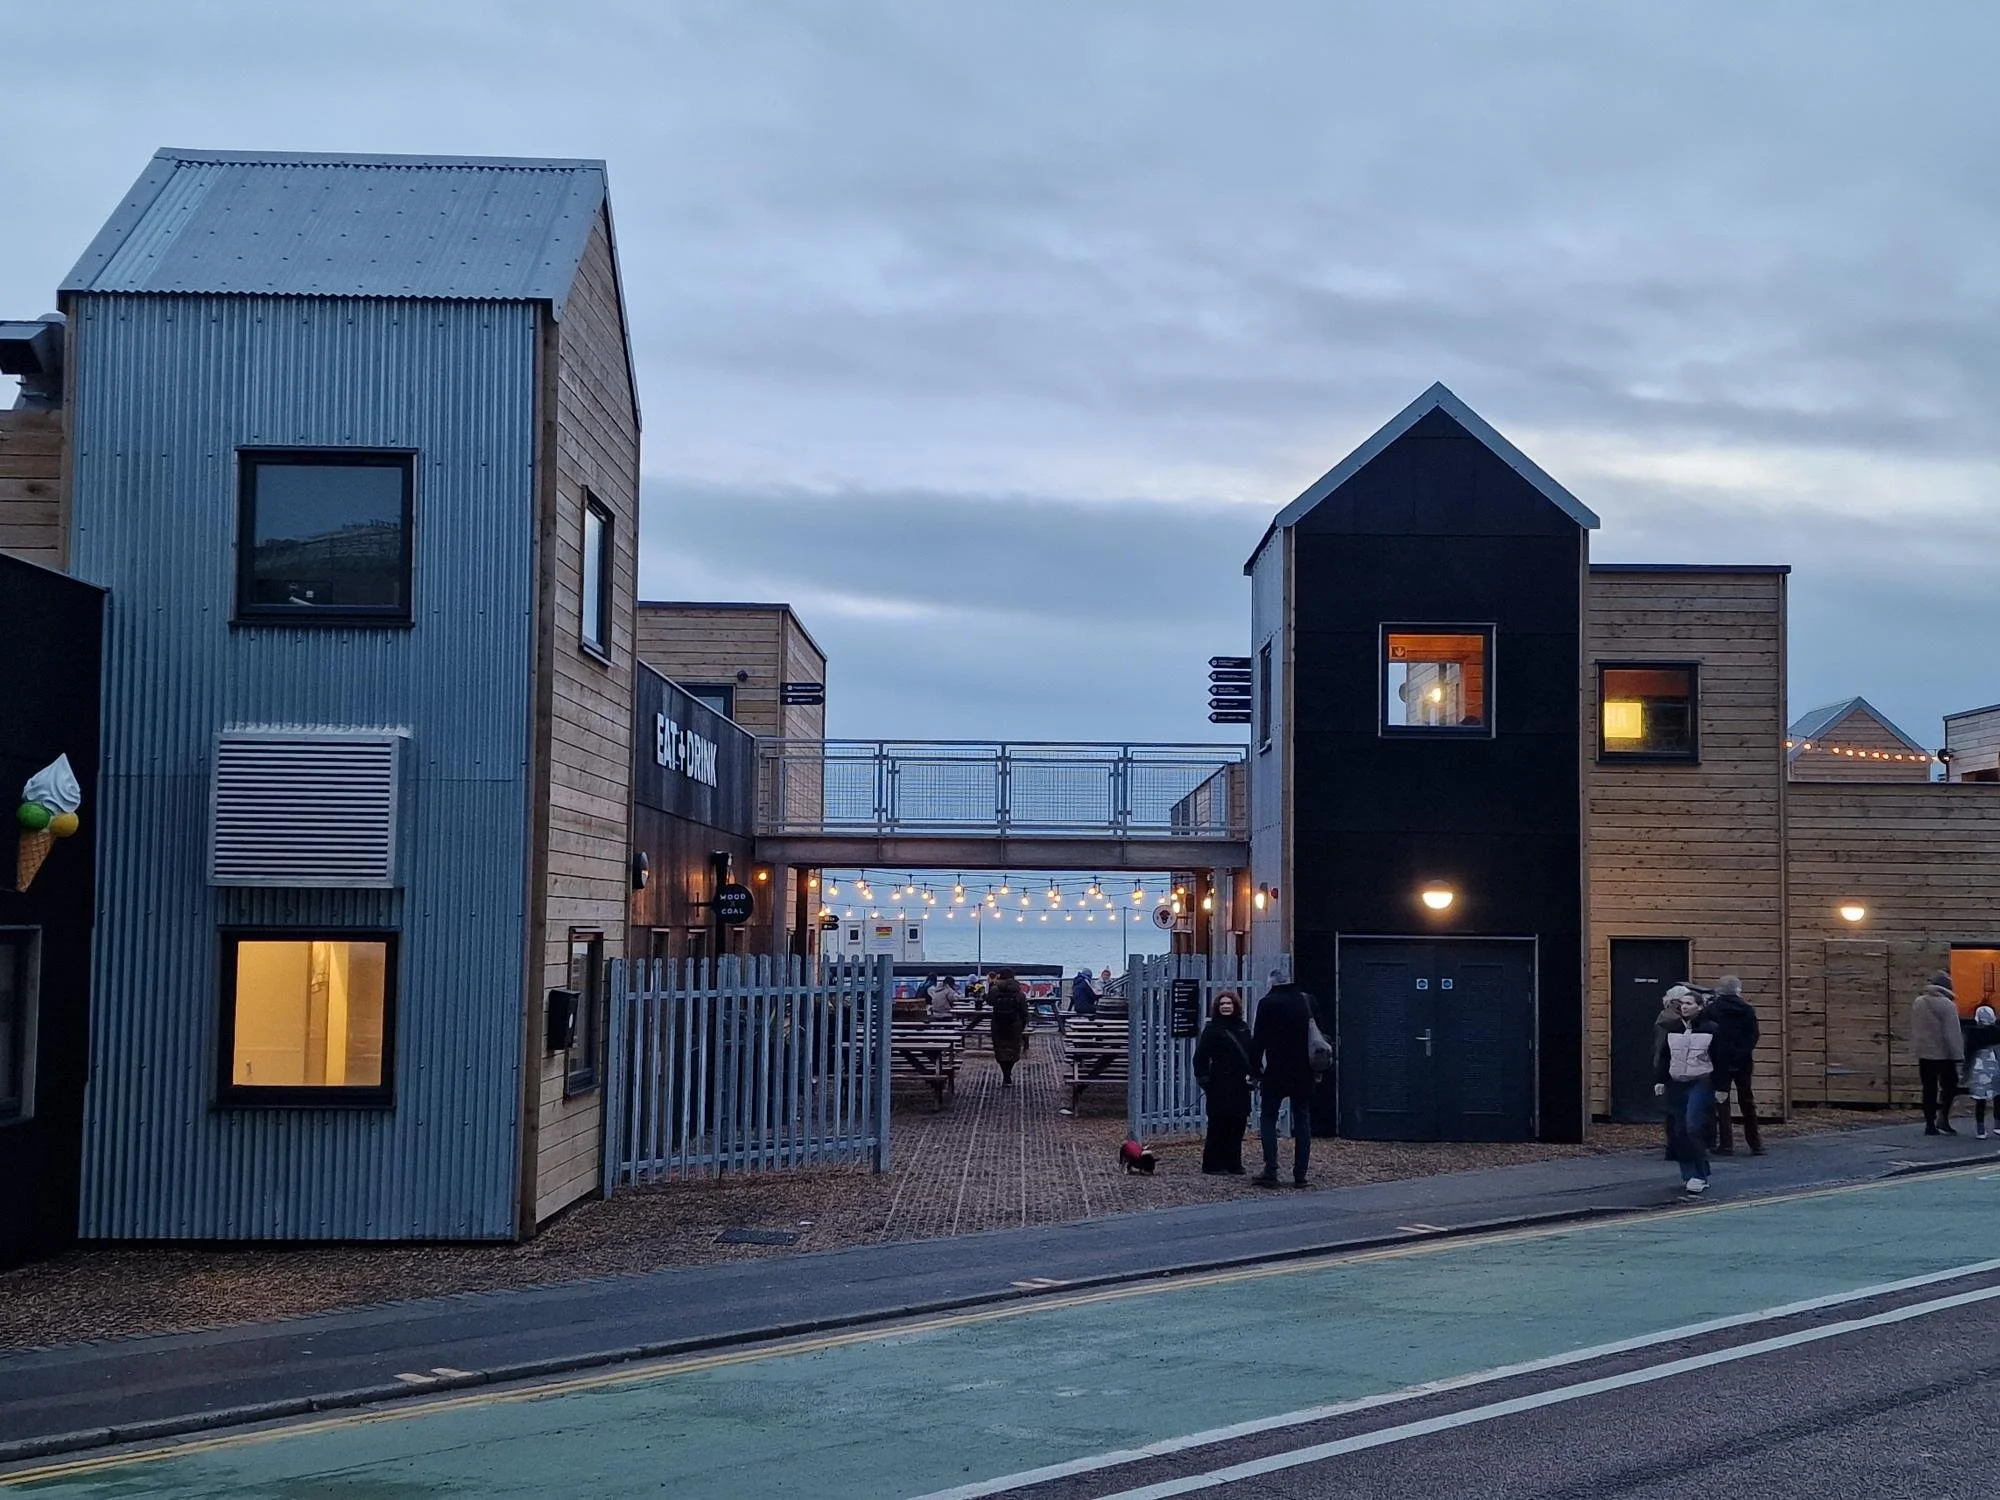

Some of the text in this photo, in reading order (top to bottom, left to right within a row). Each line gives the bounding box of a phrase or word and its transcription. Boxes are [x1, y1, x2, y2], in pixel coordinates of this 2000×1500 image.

[657, 712, 678, 771] EAT
[686, 729, 717, 788] DRINK
[721, 907, 744, 915] COAL
